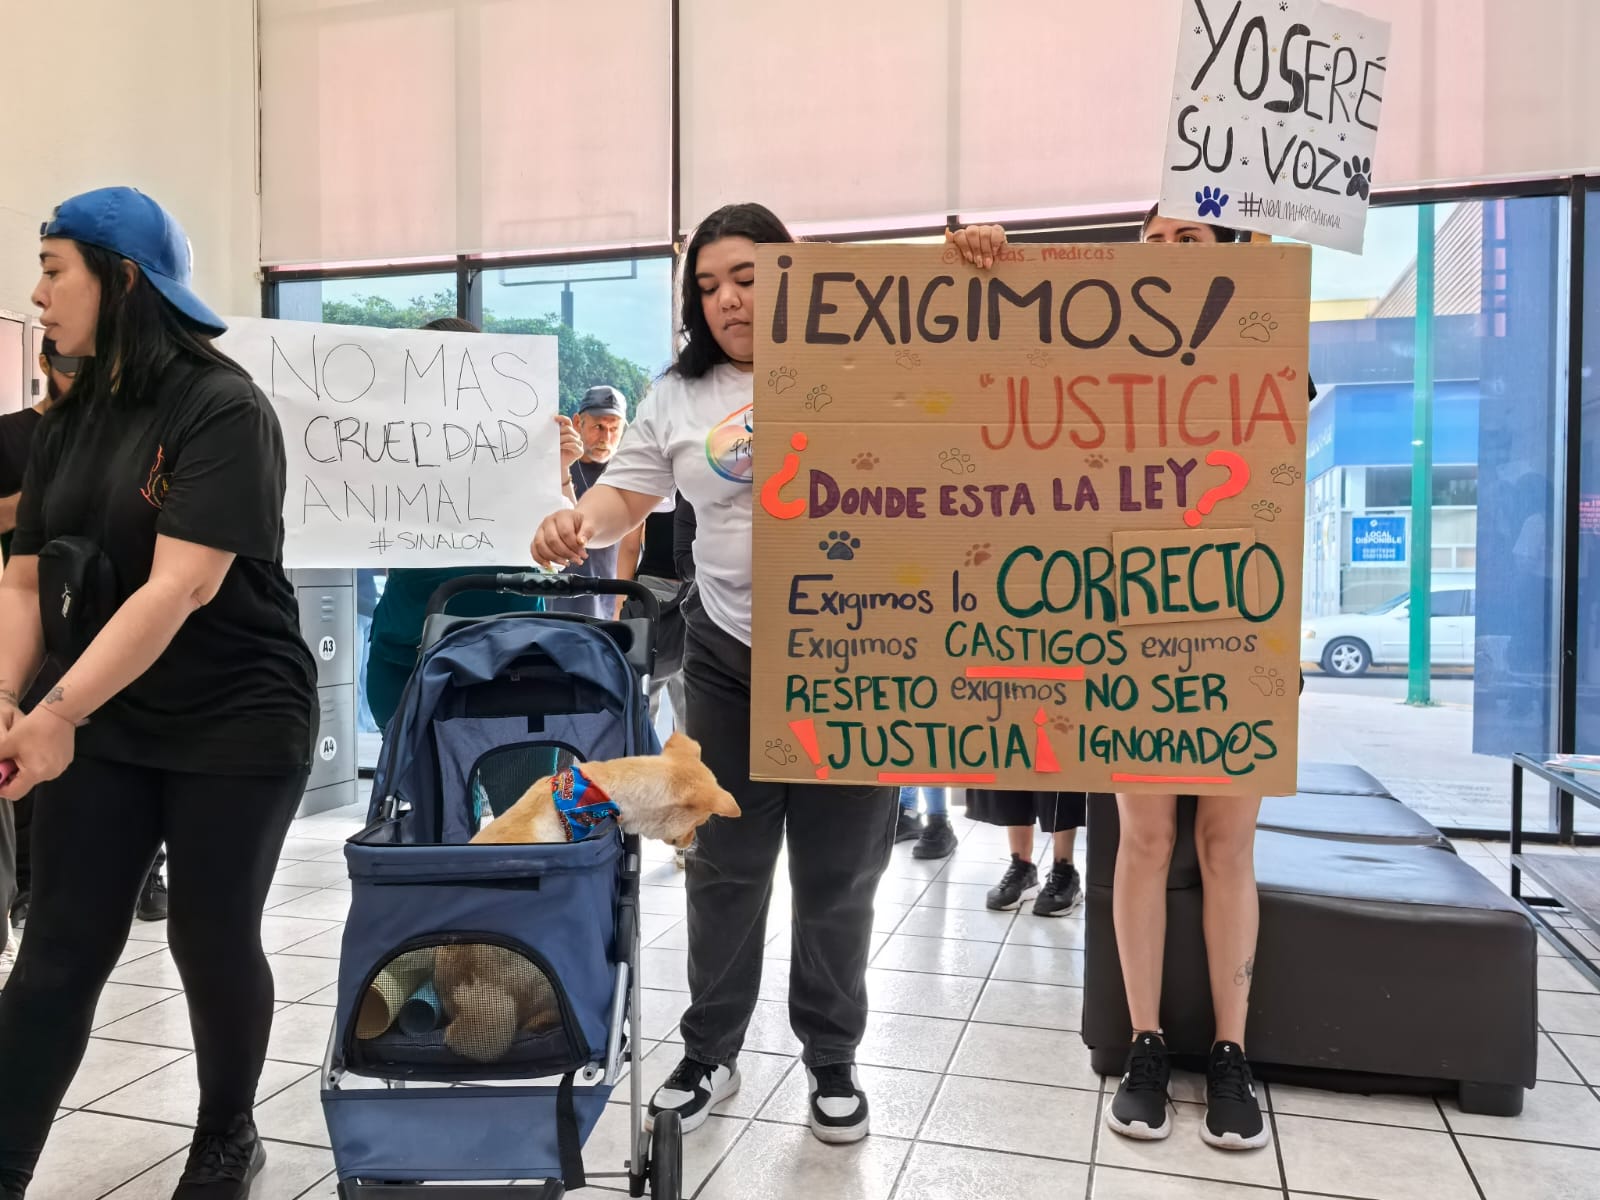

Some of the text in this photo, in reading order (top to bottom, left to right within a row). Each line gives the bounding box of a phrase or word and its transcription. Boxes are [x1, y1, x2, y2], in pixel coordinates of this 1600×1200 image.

[1191, 0, 1269, 100] YO
[1171, 105, 1341, 195] SU VOZ
[772, 256, 1235, 366] ¡EXIGIMOS!
[271, 334, 539, 417] NO MAS
[303, 474, 495, 524] ANIMAL
[939, 482, 1035, 518] ESTA
[1053, 475, 1099, 512] LA
[1119, 450, 1251, 527] LEY?
[369, 528, 494, 555] #SINALOA
[1365, 530, 1391, 538] LOCAL
[788, 542, 1284, 630] Exigimos lo CORRECTO
[323, 640, 333, 652] A3
[788, 621, 1258, 672] Exigimos CASTIGOS exigimos
[785, 674, 1228, 722] RESPETO exigimos NO SER
[324, 740, 334, 753] A4
